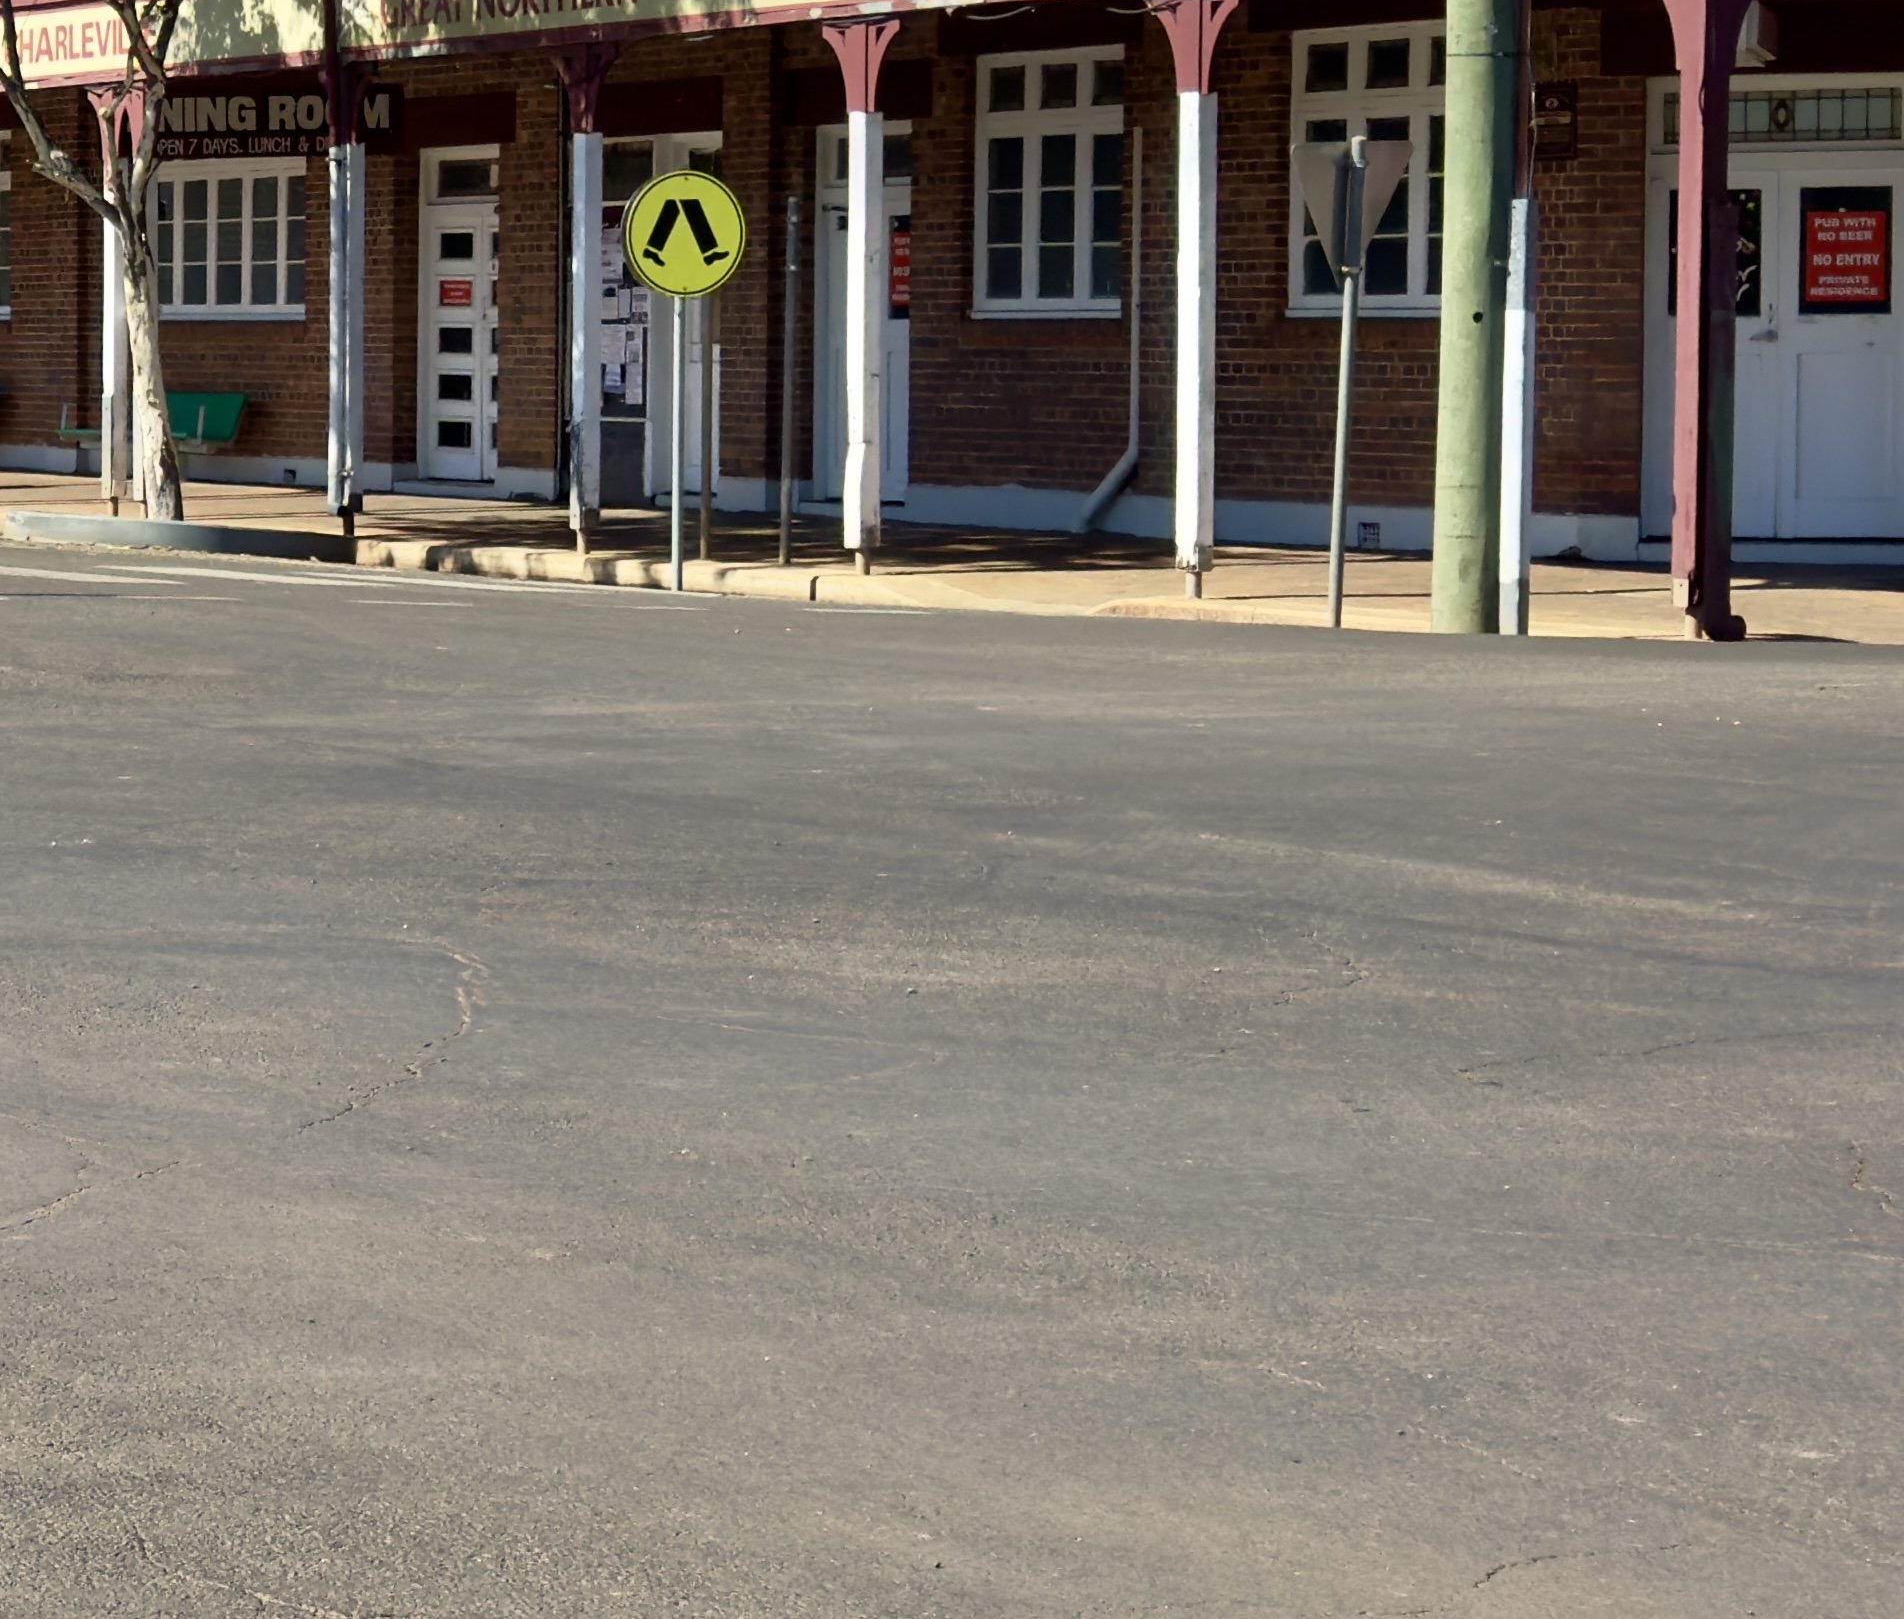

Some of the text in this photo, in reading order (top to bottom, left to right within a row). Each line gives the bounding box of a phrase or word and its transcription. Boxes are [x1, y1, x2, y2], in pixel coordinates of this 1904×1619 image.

[5, 14, 158, 66] HARLEVIL
[158, 93, 390, 132] NING ROM
[188, 138, 198, 155] 7
[248, 136, 291, 154] LUNCH
[297, 135, 310, 153] &
[1814, 217, 1876, 228] PUB WITH
[1817, 230, 1873, 241] NO BEER
[1812, 253, 1880, 266] NO ENTRY
[1818, 275, 1870, 285] PRIVATE
[1809, 286, 1879, 296] RESIDENCE
